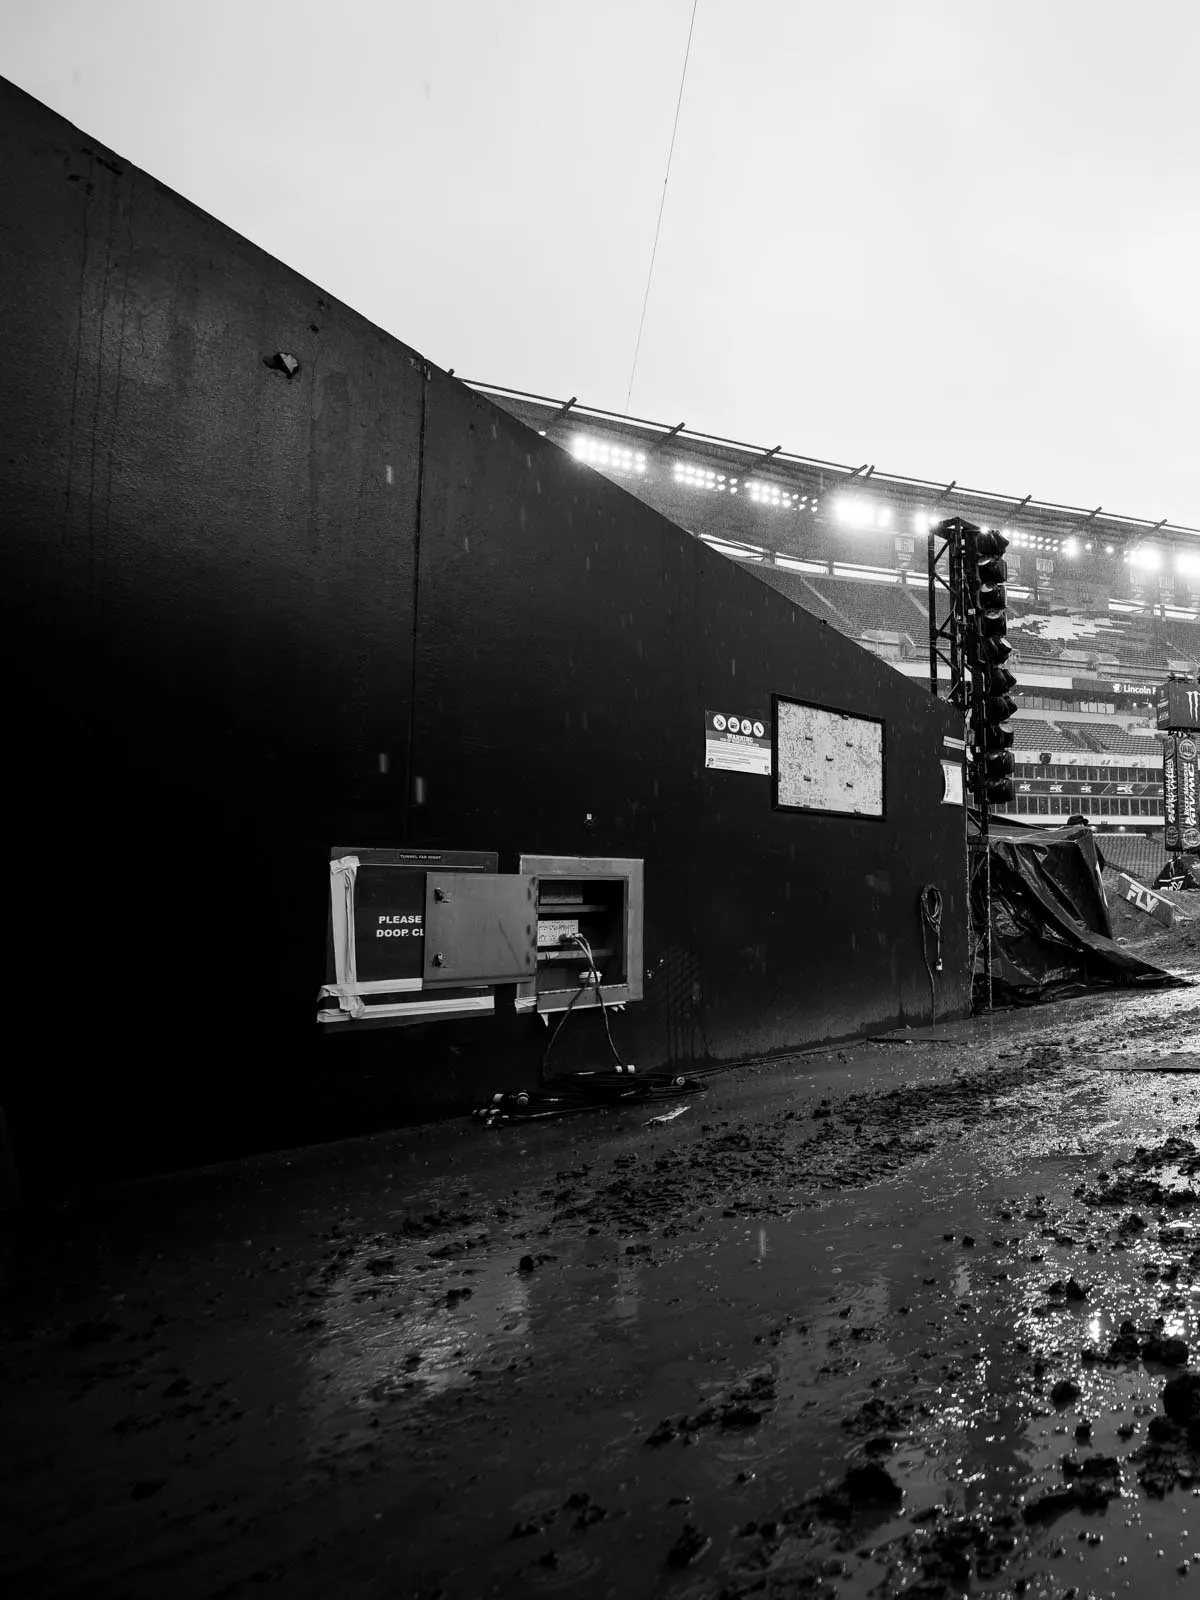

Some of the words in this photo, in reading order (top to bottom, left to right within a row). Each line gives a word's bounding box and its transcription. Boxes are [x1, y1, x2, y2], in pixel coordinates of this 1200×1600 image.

[1123, 684, 1151, 695] Lincoln
[1126, 883, 1159, 913] FLY
[378, 915, 423, 924] PLEASE
